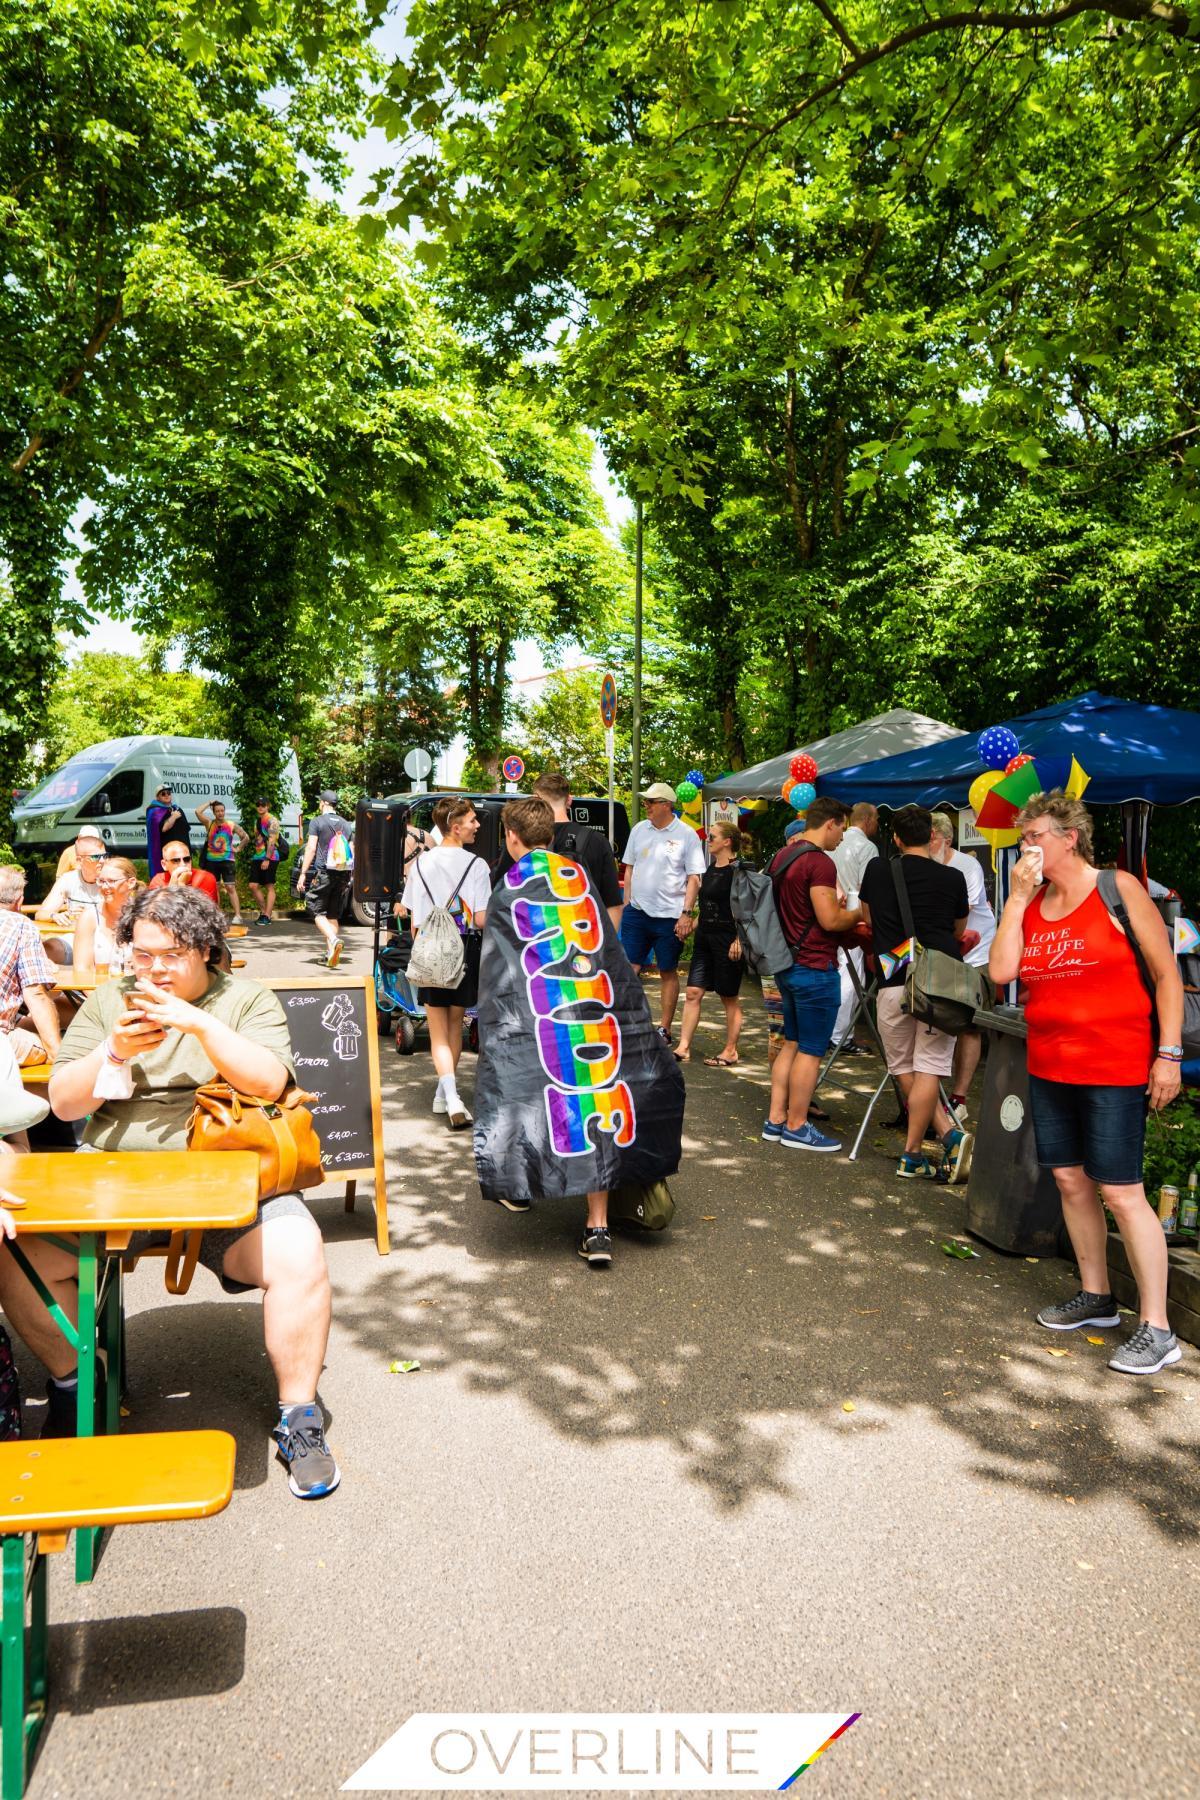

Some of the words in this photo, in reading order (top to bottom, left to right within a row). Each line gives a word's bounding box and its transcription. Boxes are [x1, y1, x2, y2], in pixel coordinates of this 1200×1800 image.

[162, 770, 188, 779] Nothing
[1030, 927, 1071, 944] LOVE
[1046, 939, 1085, 955] LIFE
[504, 848, 637, 1158] PRIDE
